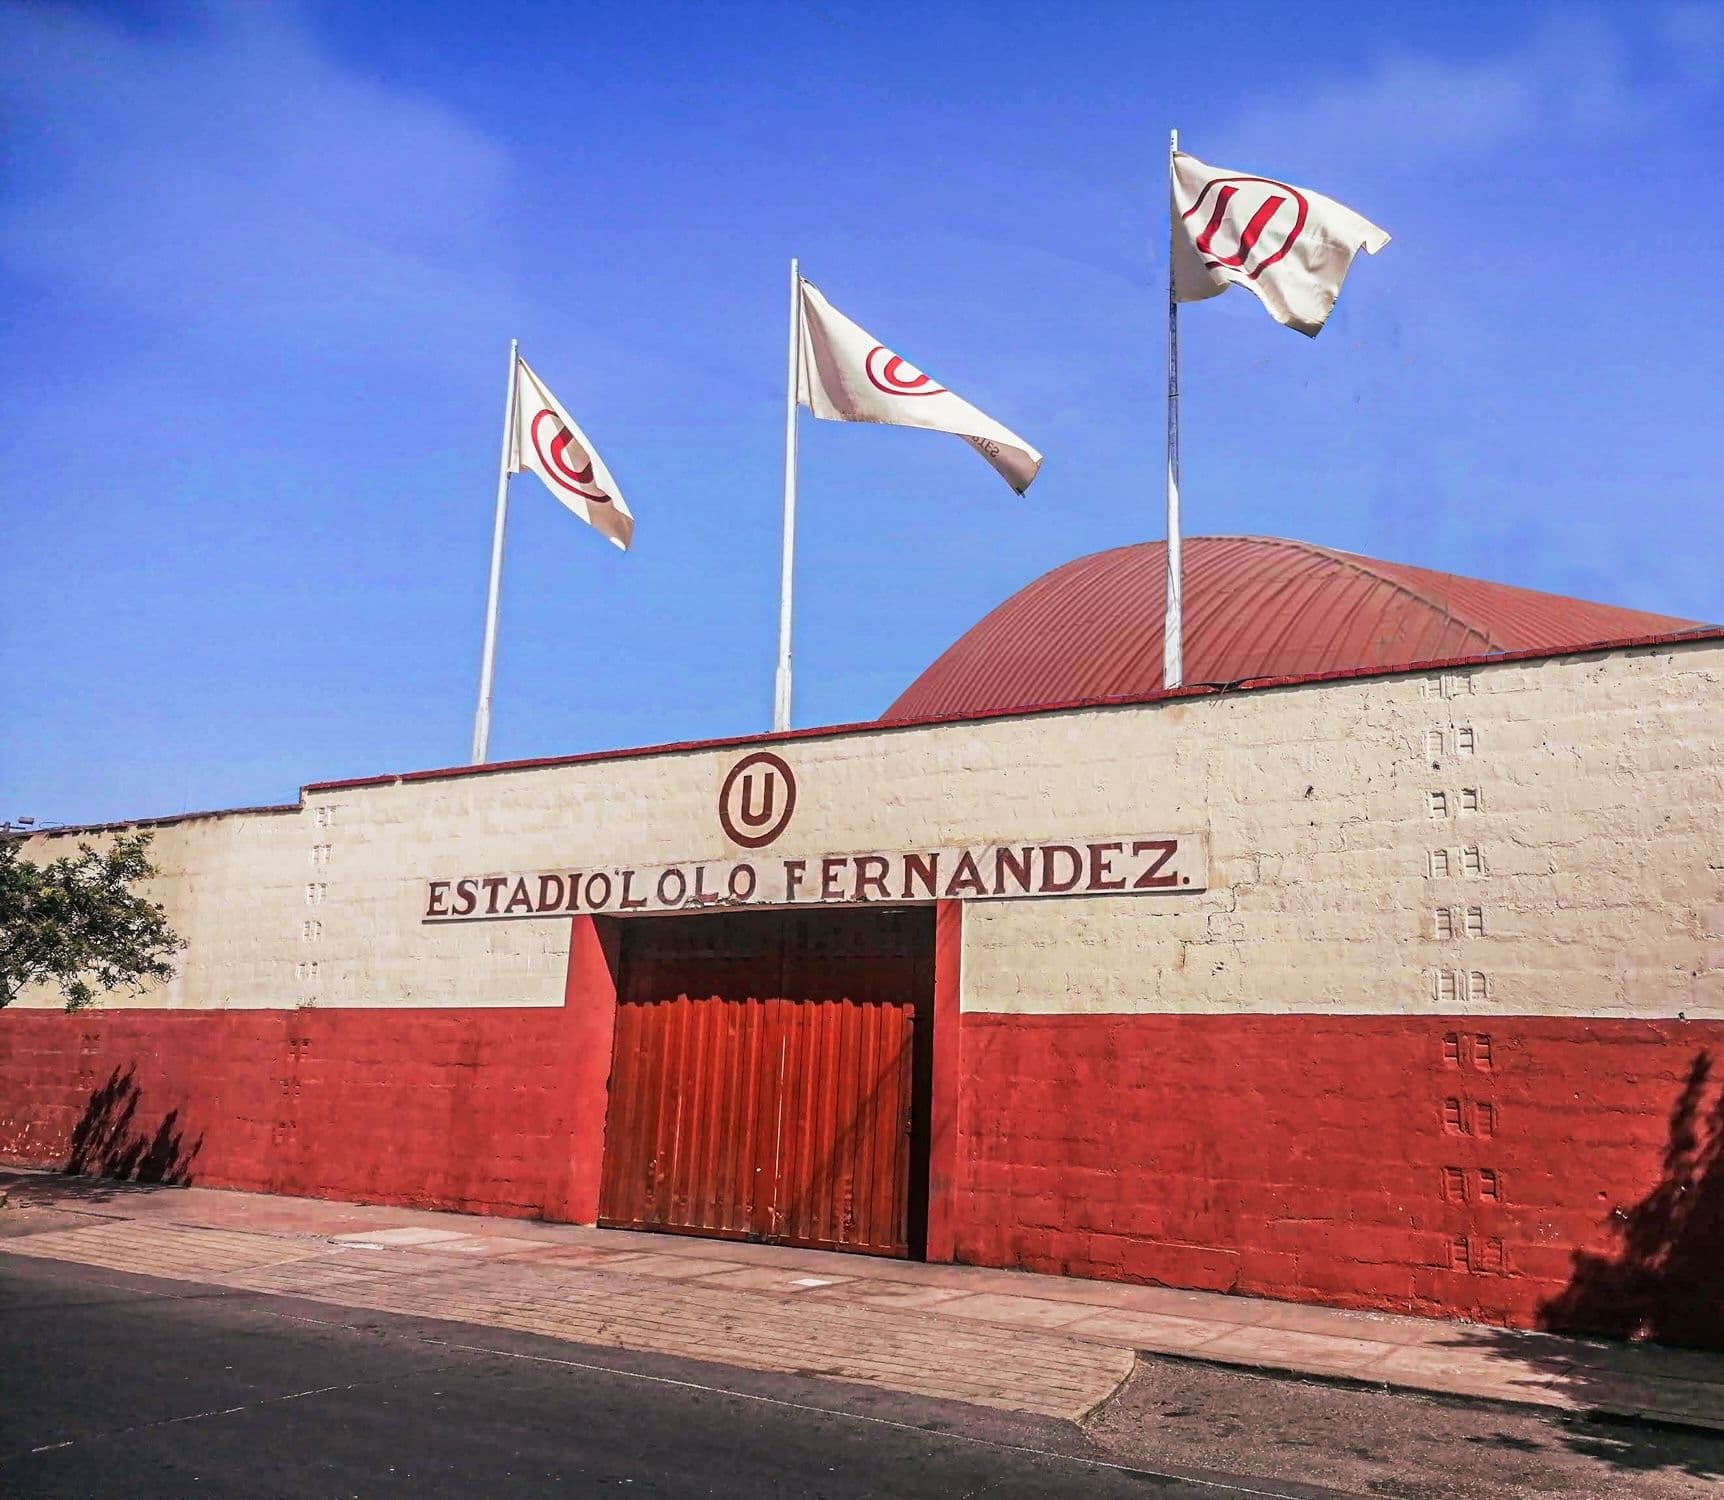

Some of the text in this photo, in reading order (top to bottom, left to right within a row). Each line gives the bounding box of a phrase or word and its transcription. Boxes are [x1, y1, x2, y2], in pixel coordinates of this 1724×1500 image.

[740, 772, 775, 826] U
[426, 839, 1191, 917] ESTADIO LOLO FERNANDEZ.
